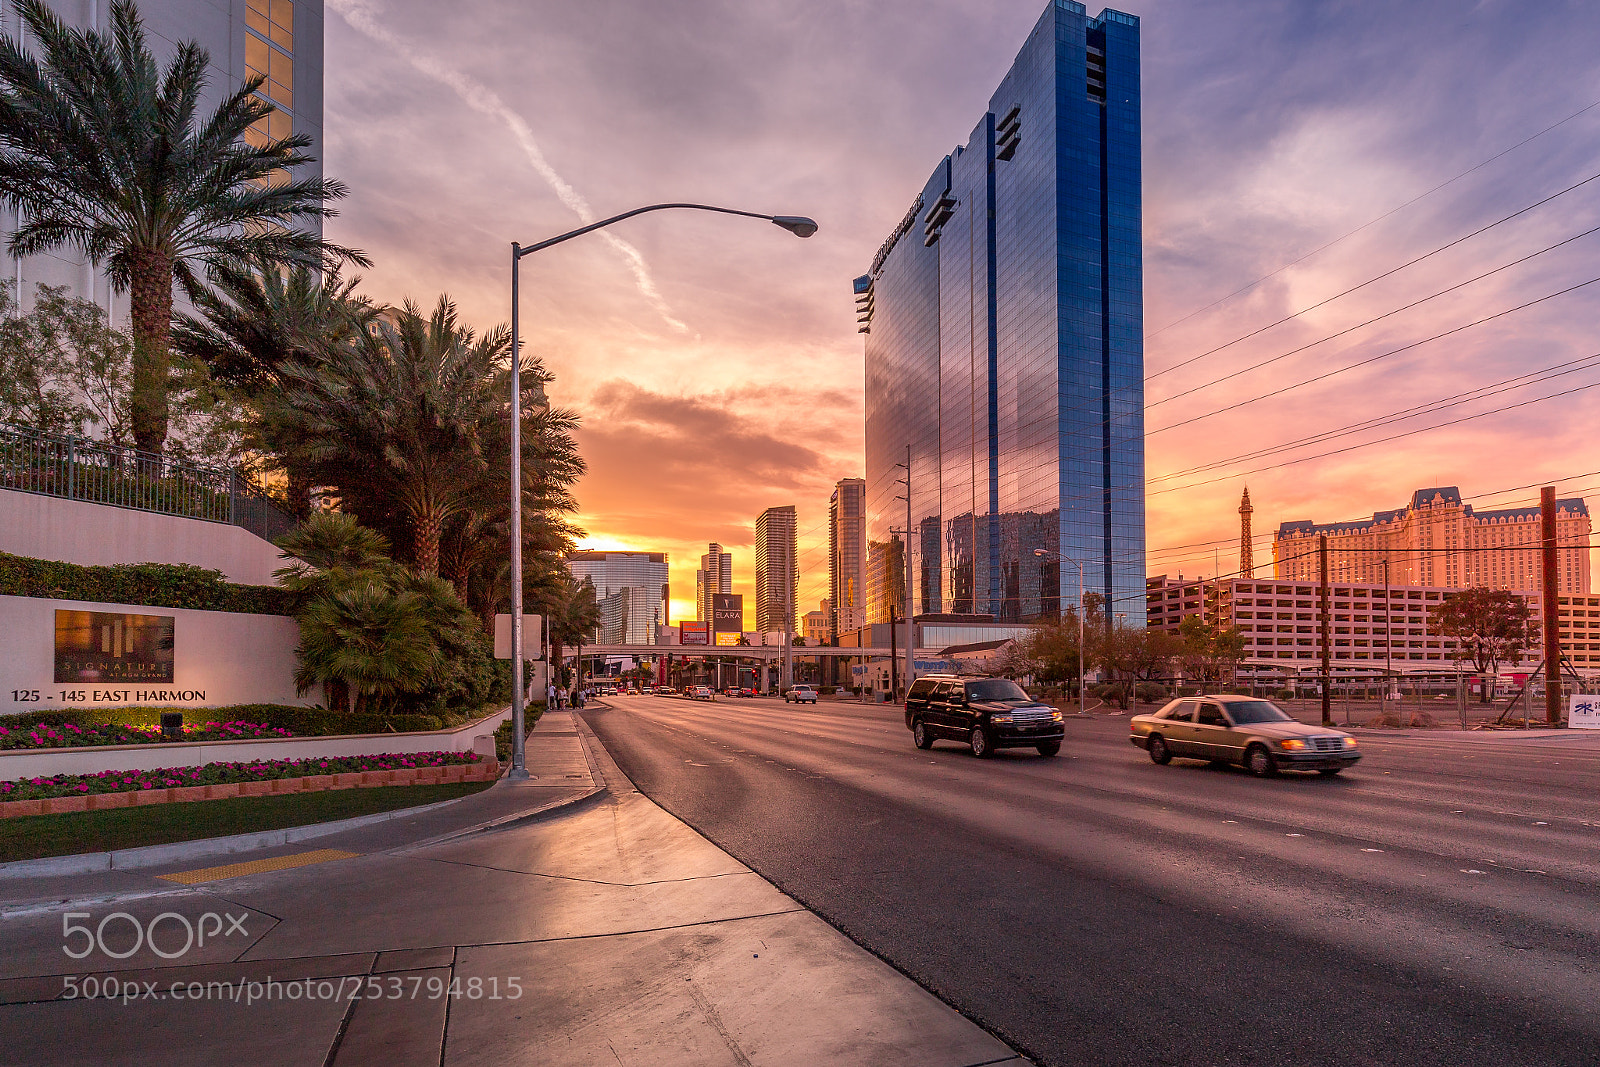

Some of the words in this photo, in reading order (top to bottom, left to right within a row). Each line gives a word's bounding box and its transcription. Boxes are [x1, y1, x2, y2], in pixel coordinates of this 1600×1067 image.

[64, 662, 167, 672] SIGNATURE
[11, 690, 40, 702] 125
[59, 690, 86, 702] 145
[92, 690, 130, 702] EAST
[136, 690, 206, 701] HARMON
